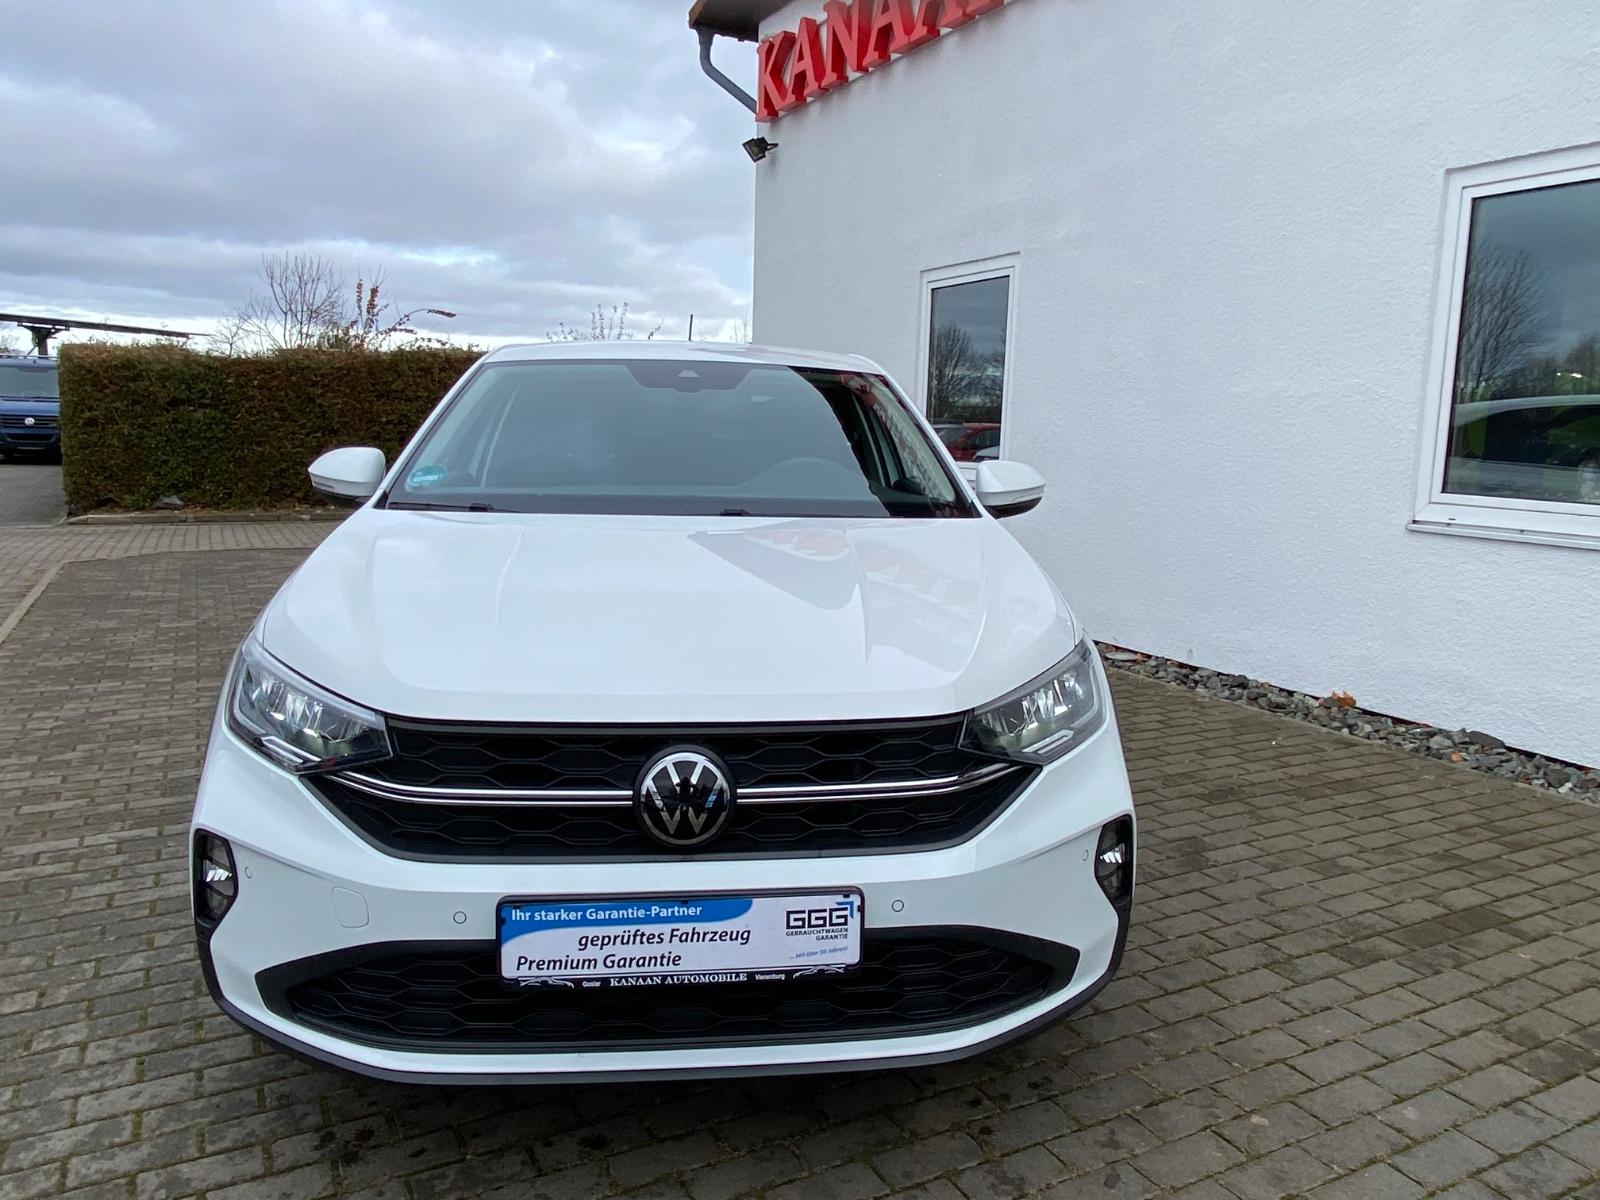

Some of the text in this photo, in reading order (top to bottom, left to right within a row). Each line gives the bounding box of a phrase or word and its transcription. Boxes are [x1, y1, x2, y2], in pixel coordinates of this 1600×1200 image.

[756, 0, 1004, 122] KANA
[511, 906, 702, 920] Ihr starker Garantie-Partner
[786, 907, 848, 929] GGG
[578, 927, 751, 951] geprüftes Fahrzeug
[786, 927, 848, 936] GEBRAUCHTWAGEN
[816, 933, 848, 941] GARANTIE
[516, 951, 682, 971] Premium Garantie
[610, 976, 661, 987] KANAAN
[665, 973, 748, 985] AUTOMOBILE
